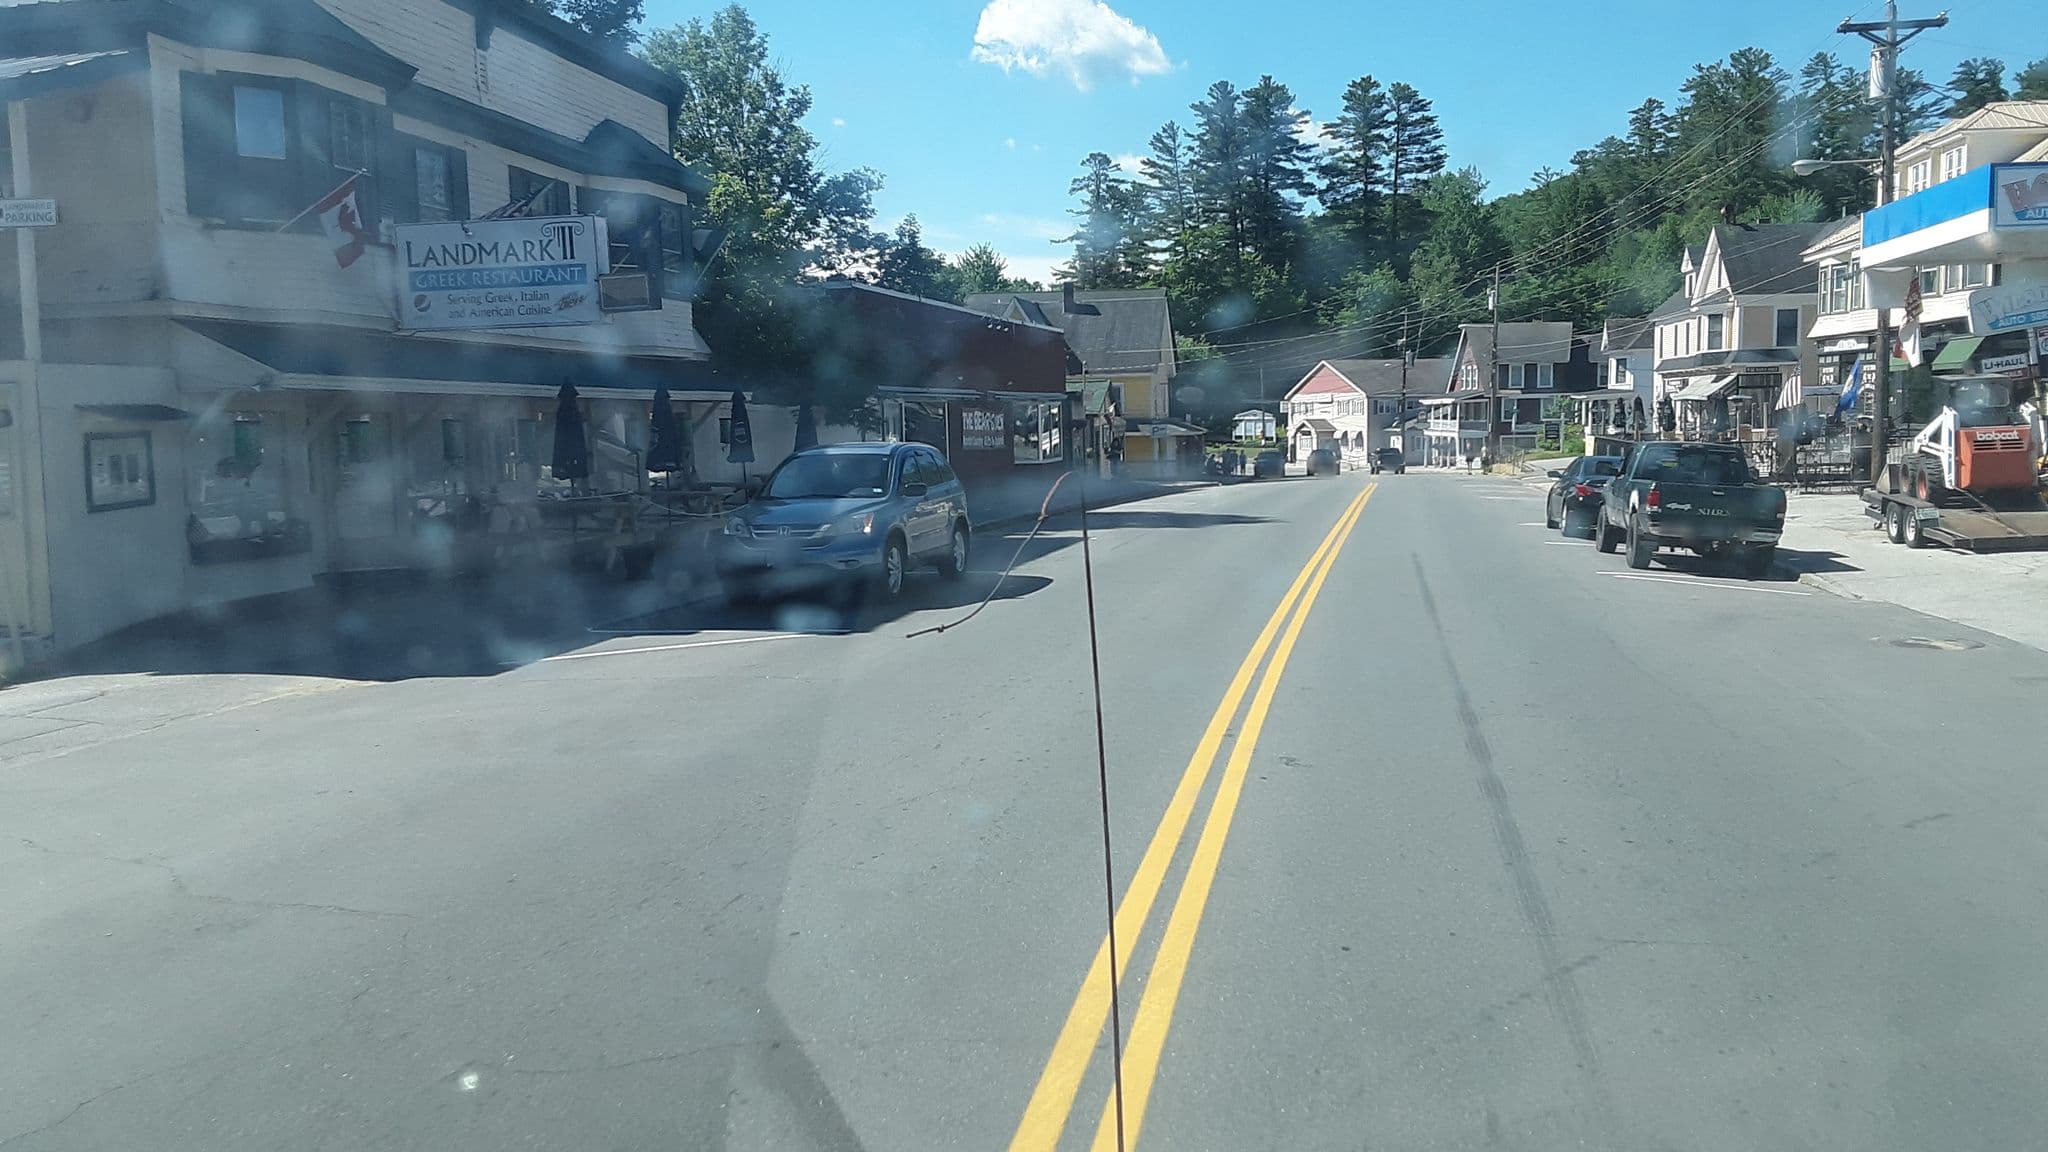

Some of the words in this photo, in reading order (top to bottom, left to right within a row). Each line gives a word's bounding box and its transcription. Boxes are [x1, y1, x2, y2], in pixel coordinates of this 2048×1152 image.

[5, 211, 53, 222] PARKING
[405, 239, 554, 268] LANDMARK
[415, 273, 467, 289] GREEK
[472, 267, 583, 287] RESTAURANT
[447, 293, 482, 306] Serving
[520, 290, 550, 302] Italian
[470, 306, 515, 319] American
[517, 304, 553, 316] Cuisine
[1999, 314, 2026, 328] AUTO
[1984, 358, 2025, 370] U-HAUL
[1976, 430, 2020, 441] bobcat
